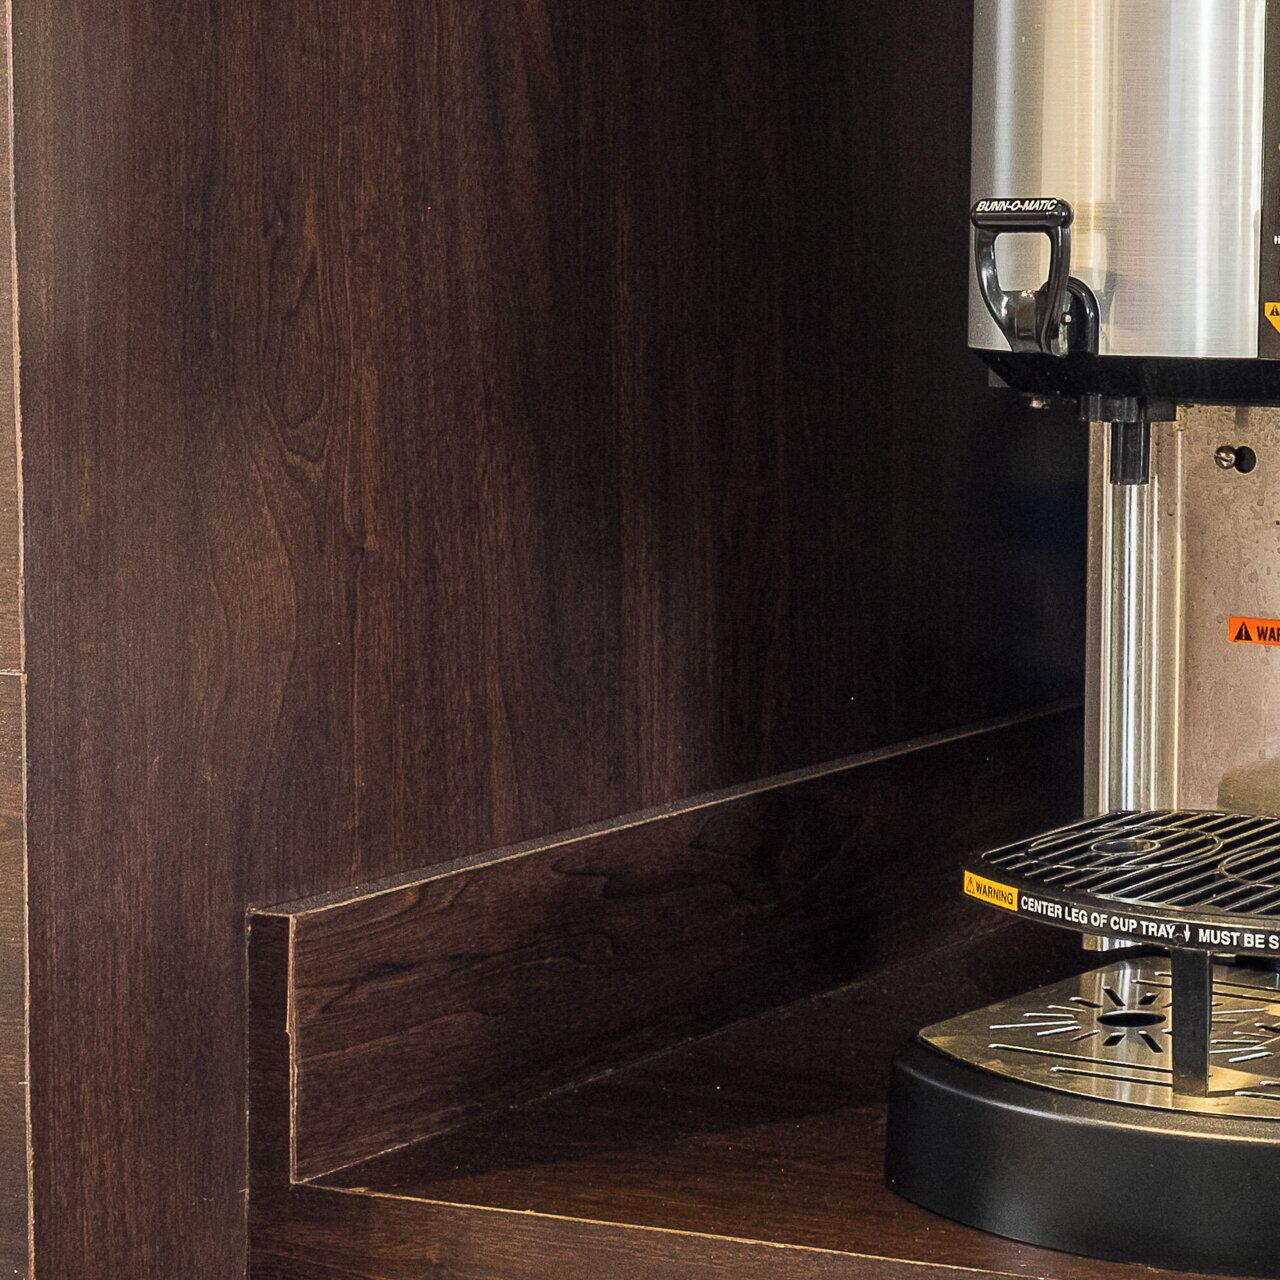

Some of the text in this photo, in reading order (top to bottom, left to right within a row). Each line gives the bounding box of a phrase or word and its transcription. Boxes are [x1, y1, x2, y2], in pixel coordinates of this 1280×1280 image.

[976, 200, 1057, 212] BUNN-O-MATIC
[975, 881, 1014, 905] WARNING
[1021, 896, 1176, 939] CENTER LEG OF CUP TRAY
[1198, 928, 1240, 946] MUST
[1244, 932, 1266, 948] BE
